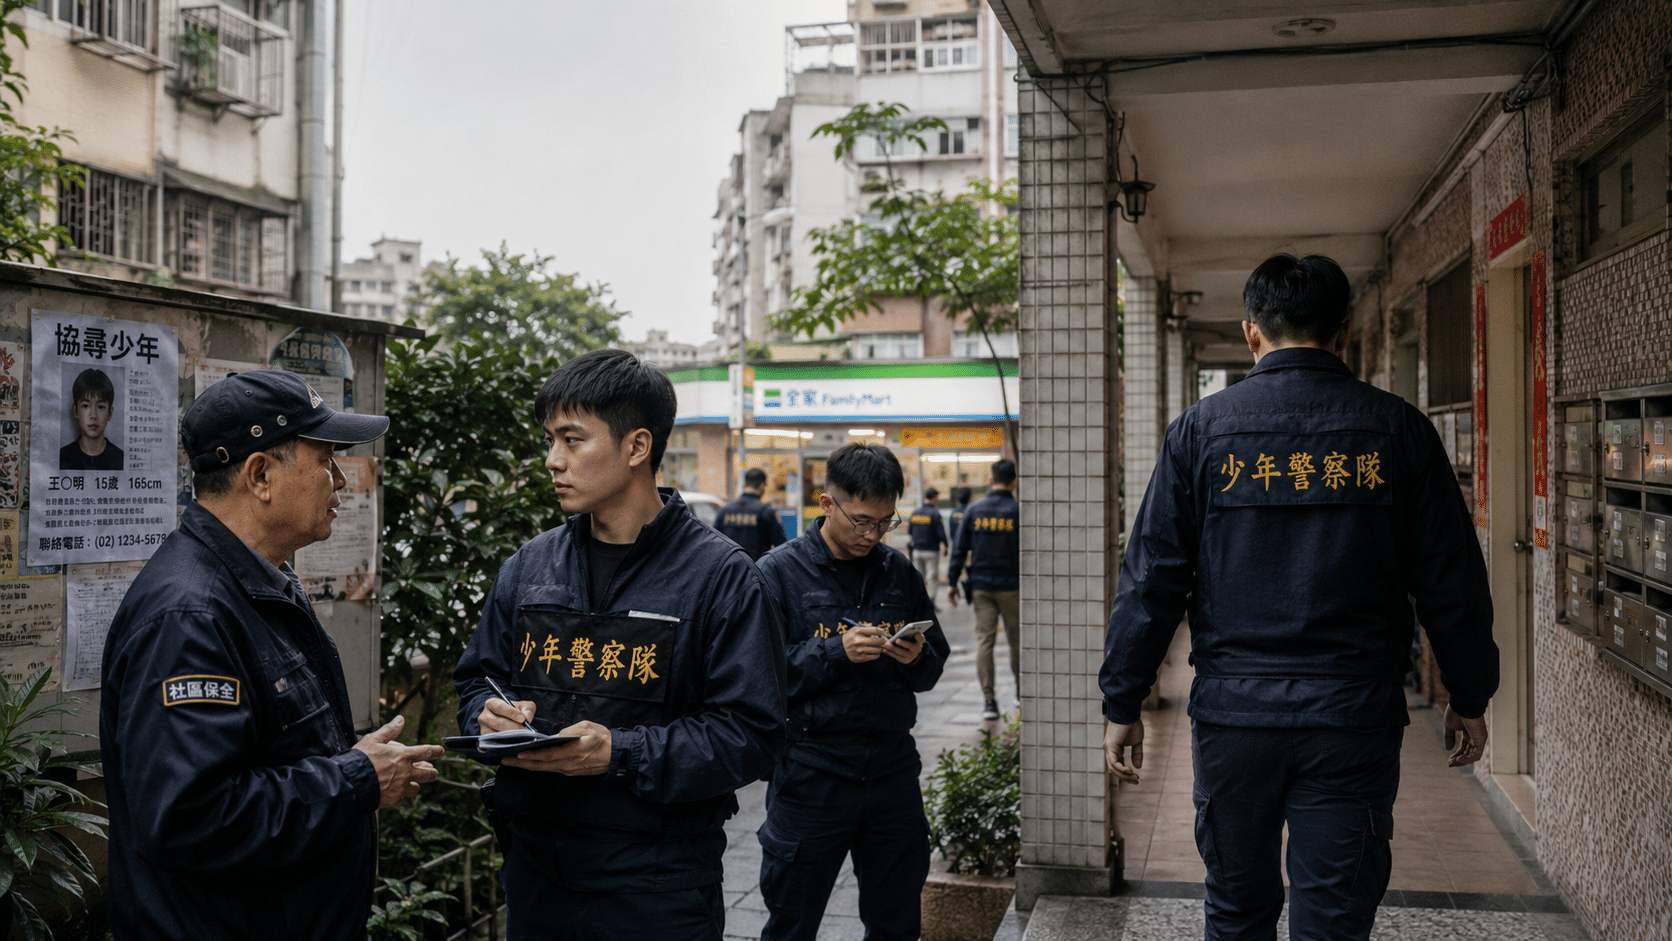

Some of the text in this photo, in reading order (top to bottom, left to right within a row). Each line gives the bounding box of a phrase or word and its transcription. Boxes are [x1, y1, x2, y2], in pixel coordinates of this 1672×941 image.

[55, 323, 160, 364] 協尋少年
[94, 476, 119, 491] 15歲
[128, 477, 162, 490] 165cm
[1220, 451, 1386, 492] 少年警察隊
[520, 632, 660, 684] 少年警察隊
[168, 681, 235, 700] 社區保全
